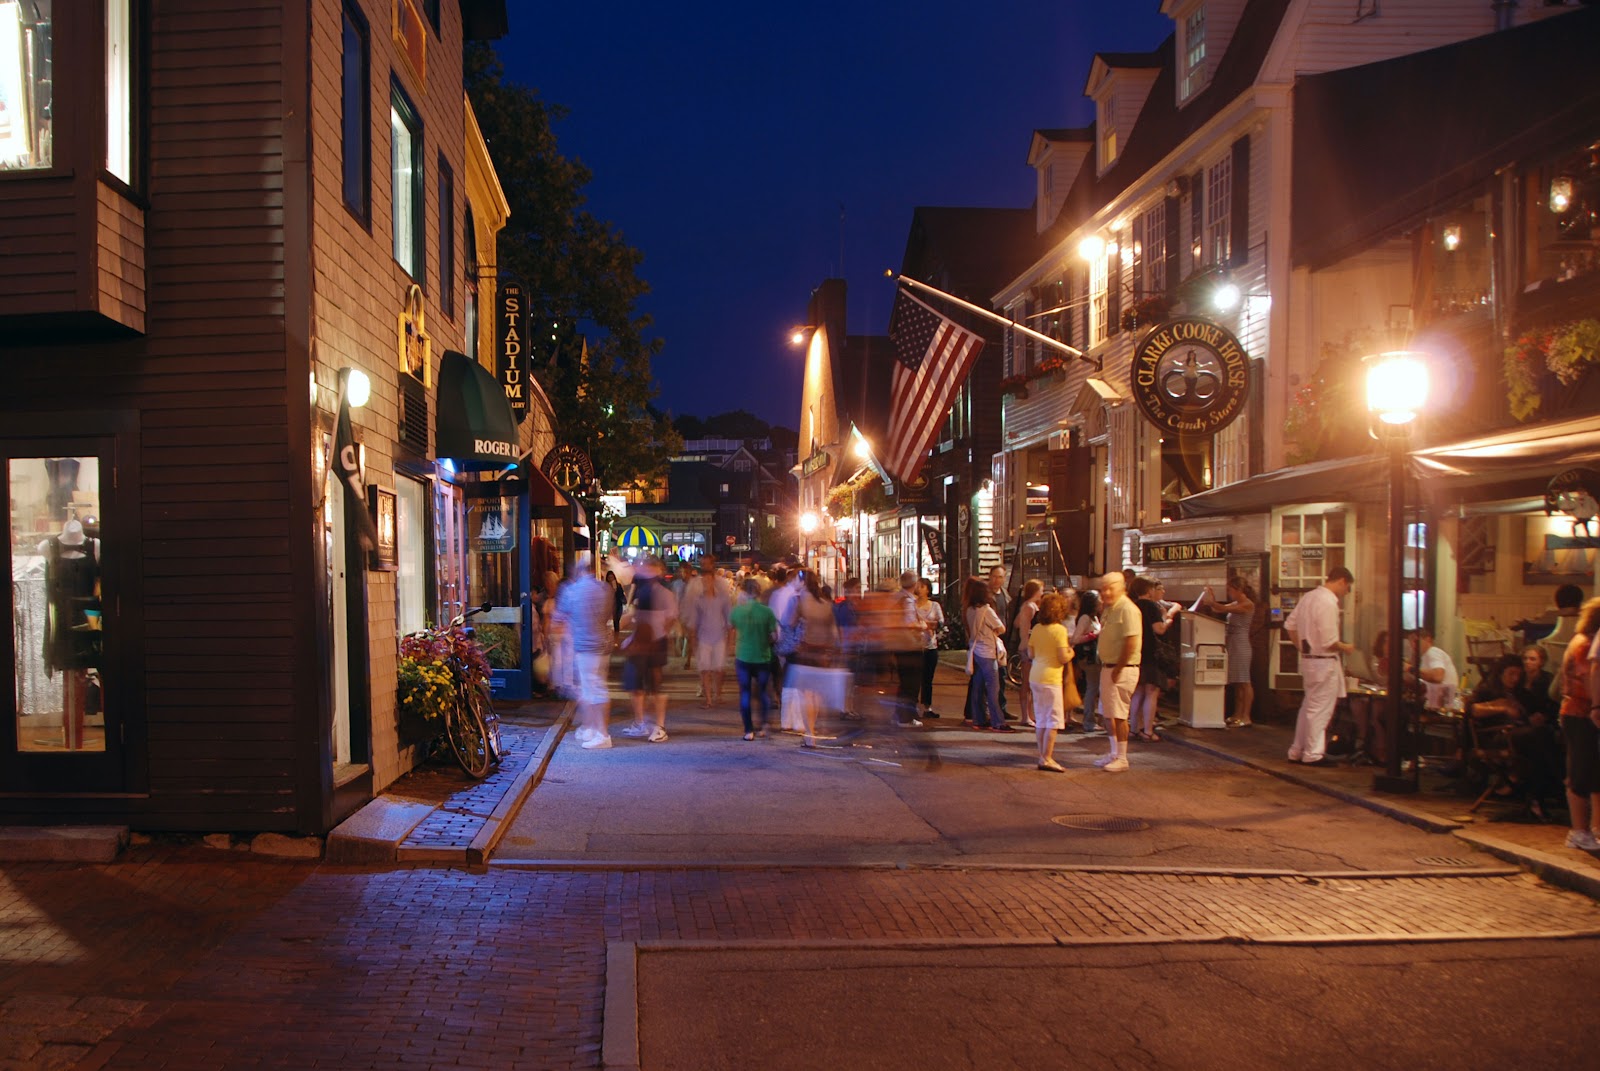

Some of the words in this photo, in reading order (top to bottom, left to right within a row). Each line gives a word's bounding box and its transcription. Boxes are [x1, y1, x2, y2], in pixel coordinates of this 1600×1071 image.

[504, 298, 522, 398] STADIUM
[1137, 330, 1174, 386] CLARKE
[1172, 322, 1224, 347] COOKE
[1218, 339, 1245, 389] HOUSE
[1145, 394, 1166, 419] The
[1167, 413, 1208, 432] Candy
[1210, 397, 1238, 424] Store
[474, 440, 511, 456] ROGER
[1168, 545, 1194, 560] BISTRO
